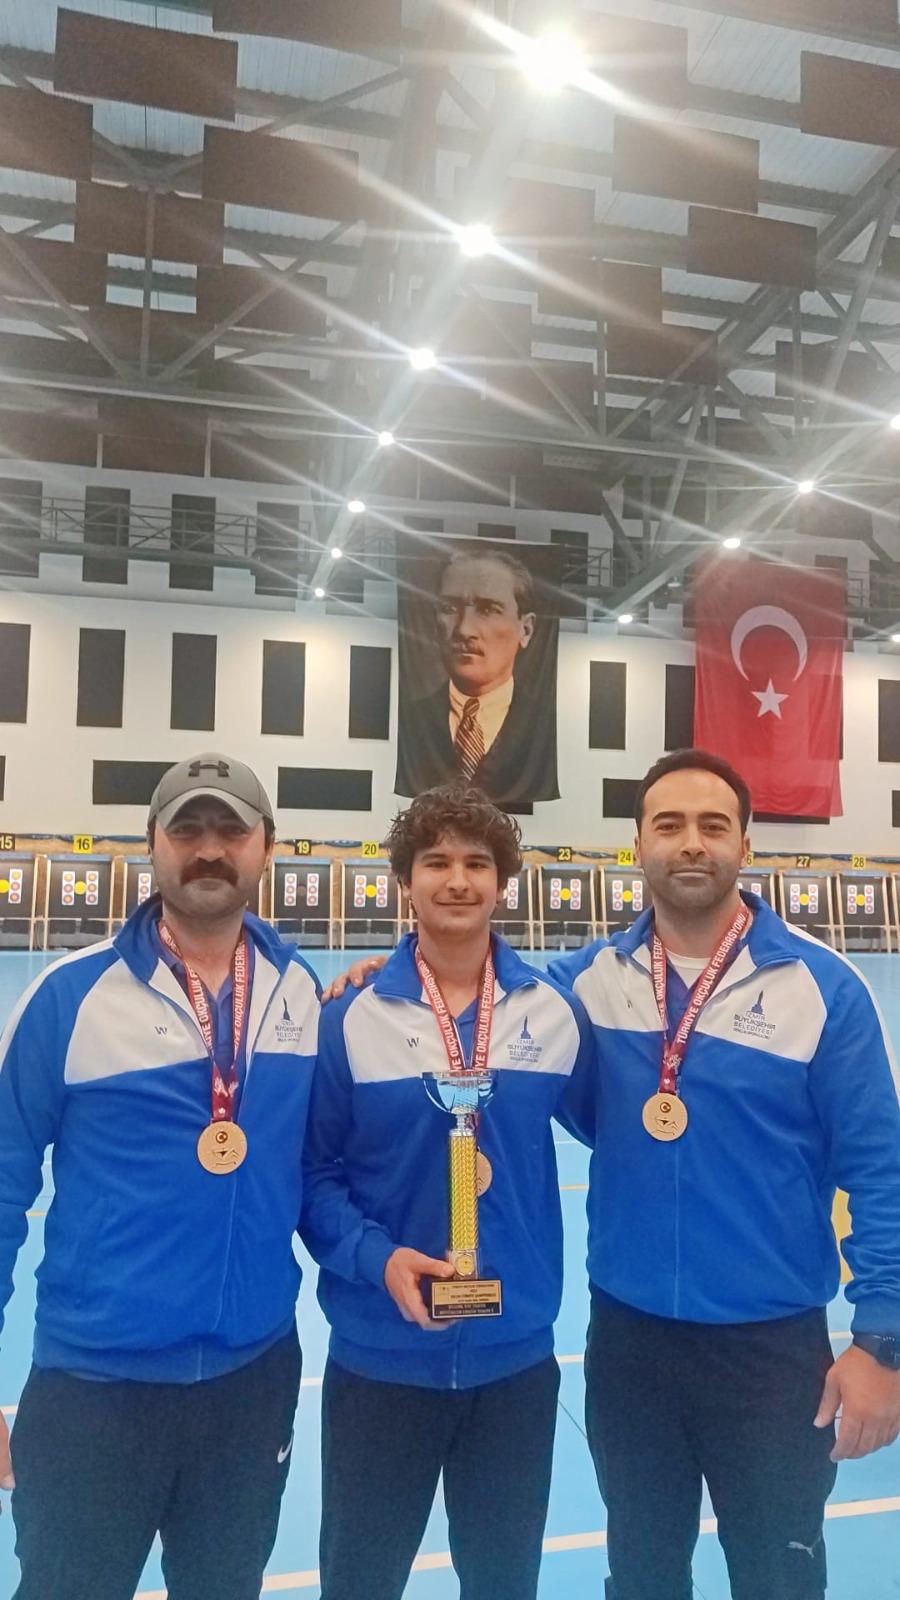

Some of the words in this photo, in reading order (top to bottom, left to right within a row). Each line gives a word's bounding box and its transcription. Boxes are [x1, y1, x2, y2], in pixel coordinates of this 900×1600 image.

[0, 835, 13, 849] 15
[76, 838, 90, 850] 16
[297, 840, 310, 854] 19
[364, 843, 377, 855] 20
[558, 848, 571, 861] 23
[619, 851, 632, 862] 24
[797, 856, 810, 867] 27
[853, 857, 865, 867] 28
[676, 1004, 700, 1044] TÜRKİYE
[692, 966, 719, 1007] OKÇULUK
[712, 913, 747, 970] FEDERASYONU
[440, 1013, 460, 1057] OKÇULUK
[477, 1010, 491, 1052] OKÇULUK
